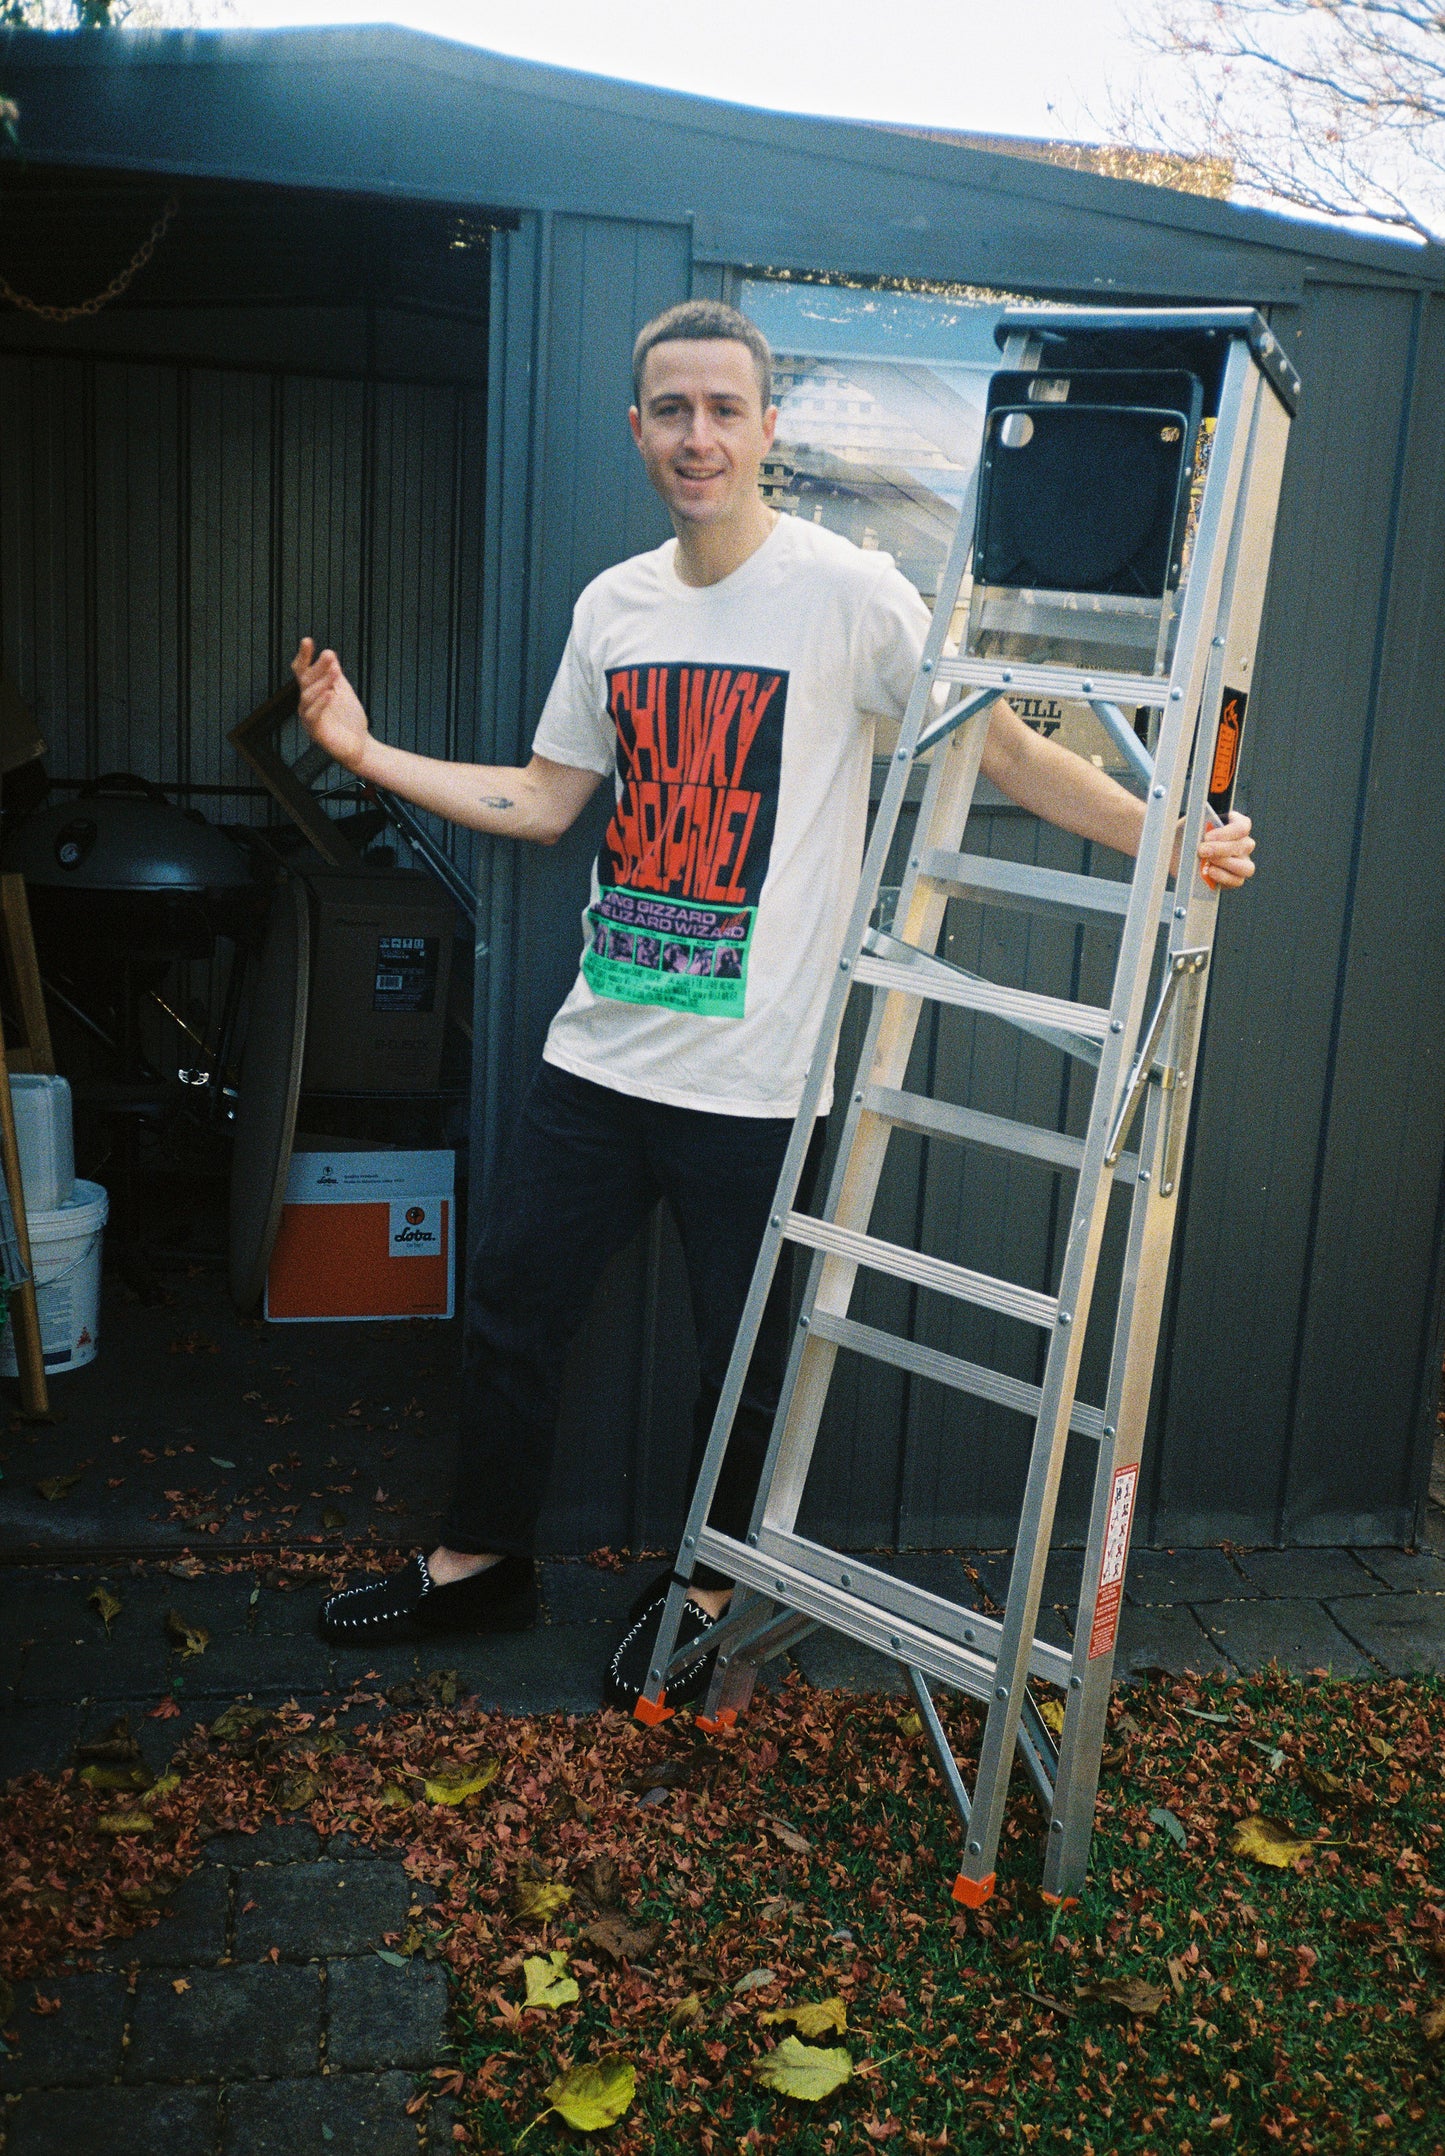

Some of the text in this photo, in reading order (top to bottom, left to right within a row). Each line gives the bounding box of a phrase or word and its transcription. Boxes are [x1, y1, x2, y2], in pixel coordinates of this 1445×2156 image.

[611, 668, 781, 788] CHUNKY
[611, 906, 672, 931] LIZARD
[637, 900, 717, 924] GIZZARD
